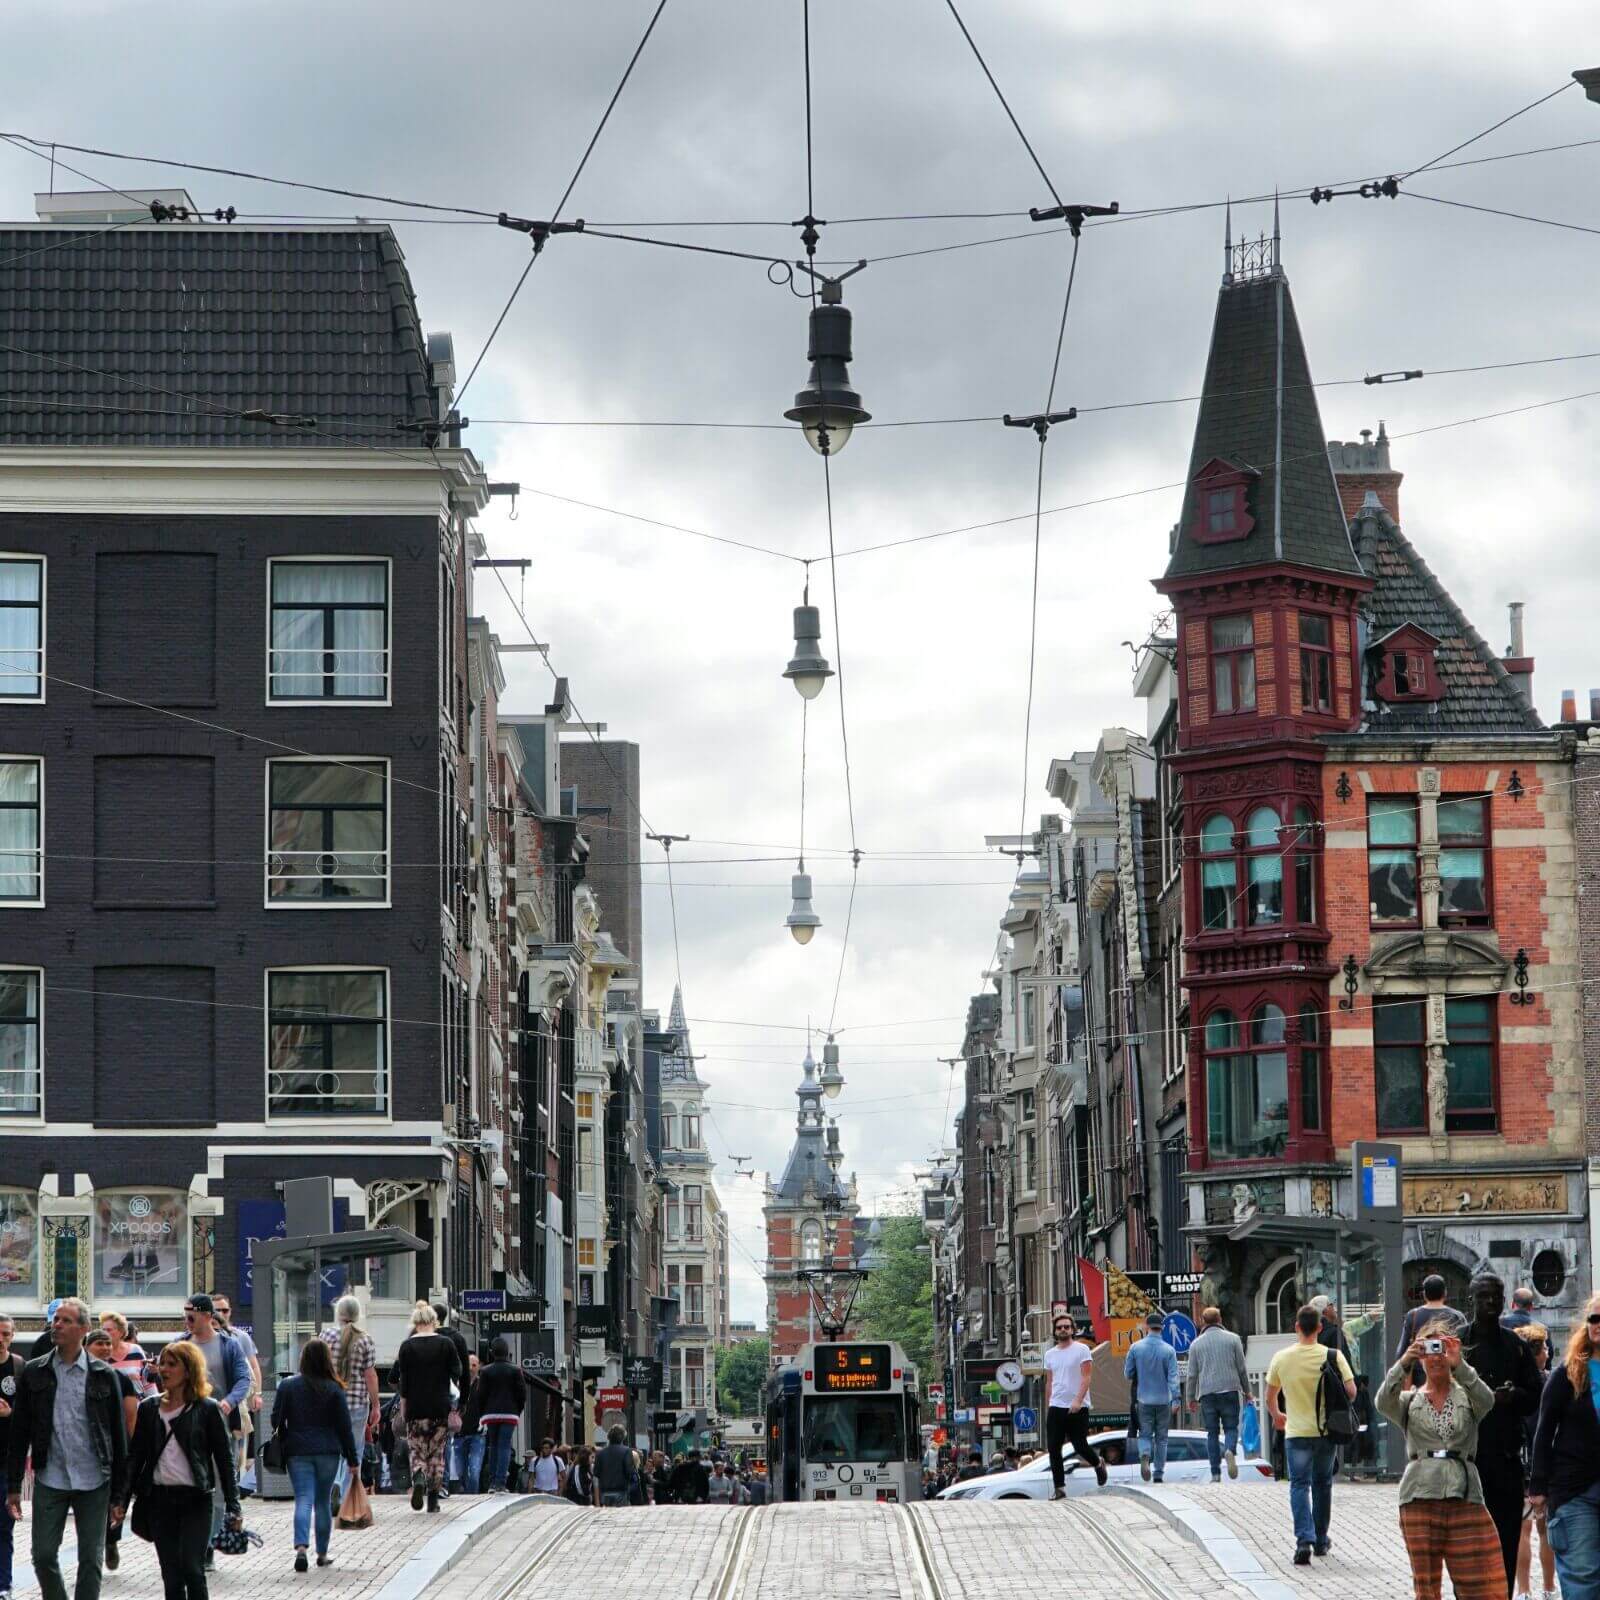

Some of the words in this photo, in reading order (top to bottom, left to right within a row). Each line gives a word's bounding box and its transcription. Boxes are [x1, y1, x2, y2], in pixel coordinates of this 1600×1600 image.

[110, 1222, 171, 1233] XPOOOS
[1165, 1274, 1204, 1284] SMART
[838, 1351, 848, 1368] 5
